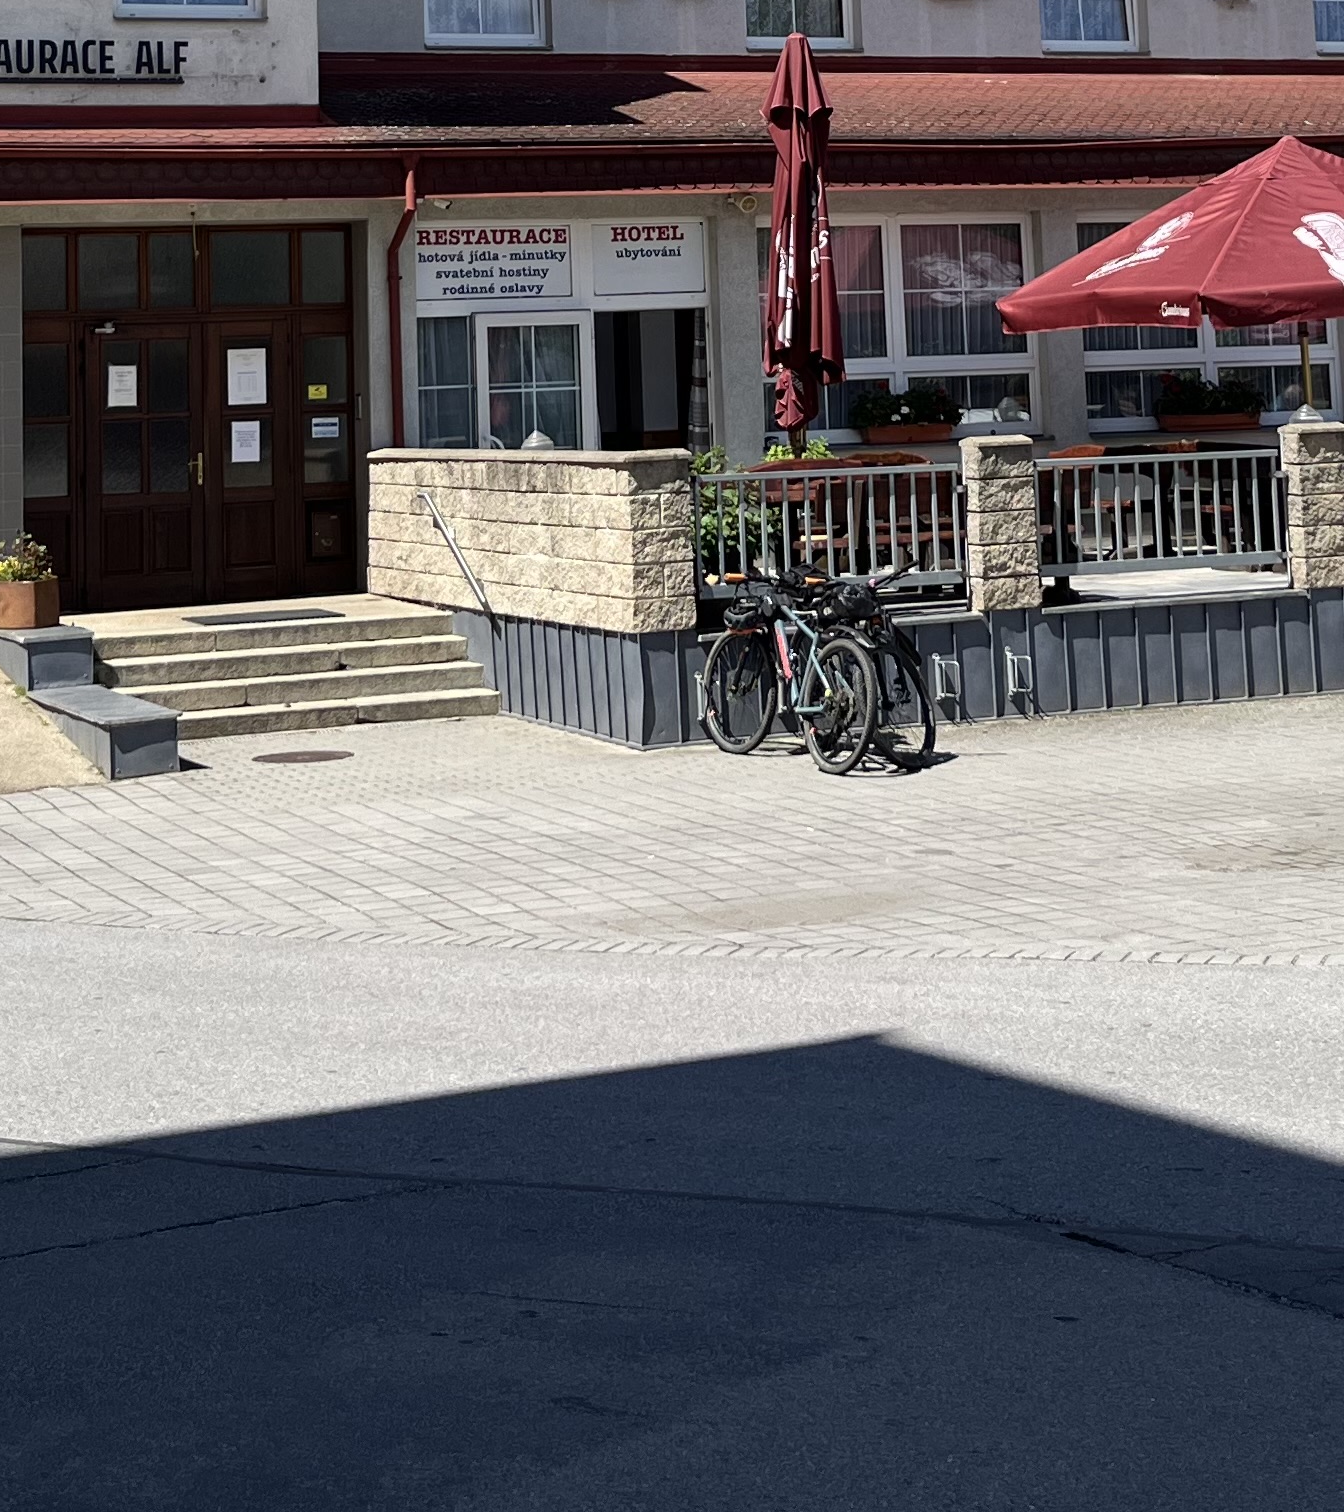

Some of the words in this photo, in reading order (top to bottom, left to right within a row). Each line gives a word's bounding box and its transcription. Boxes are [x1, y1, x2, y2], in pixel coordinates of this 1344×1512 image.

[135, 40, 190, 75] ALF
[416, 228, 567, 246] RESTAURACE
[610, 225, 685, 242] HOTEL
[418, 249, 465, 264] hotová
[468, 248, 500, 264] jídla
[509, 249, 567, 262] minutky
[615, 245, 682, 259] ubytování
[435, 266, 494, 279] svatební
[499, 266, 549, 279] hostiny
[442, 281, 495, 295] rodinné
[500, 283, 545, 294] oslavy
